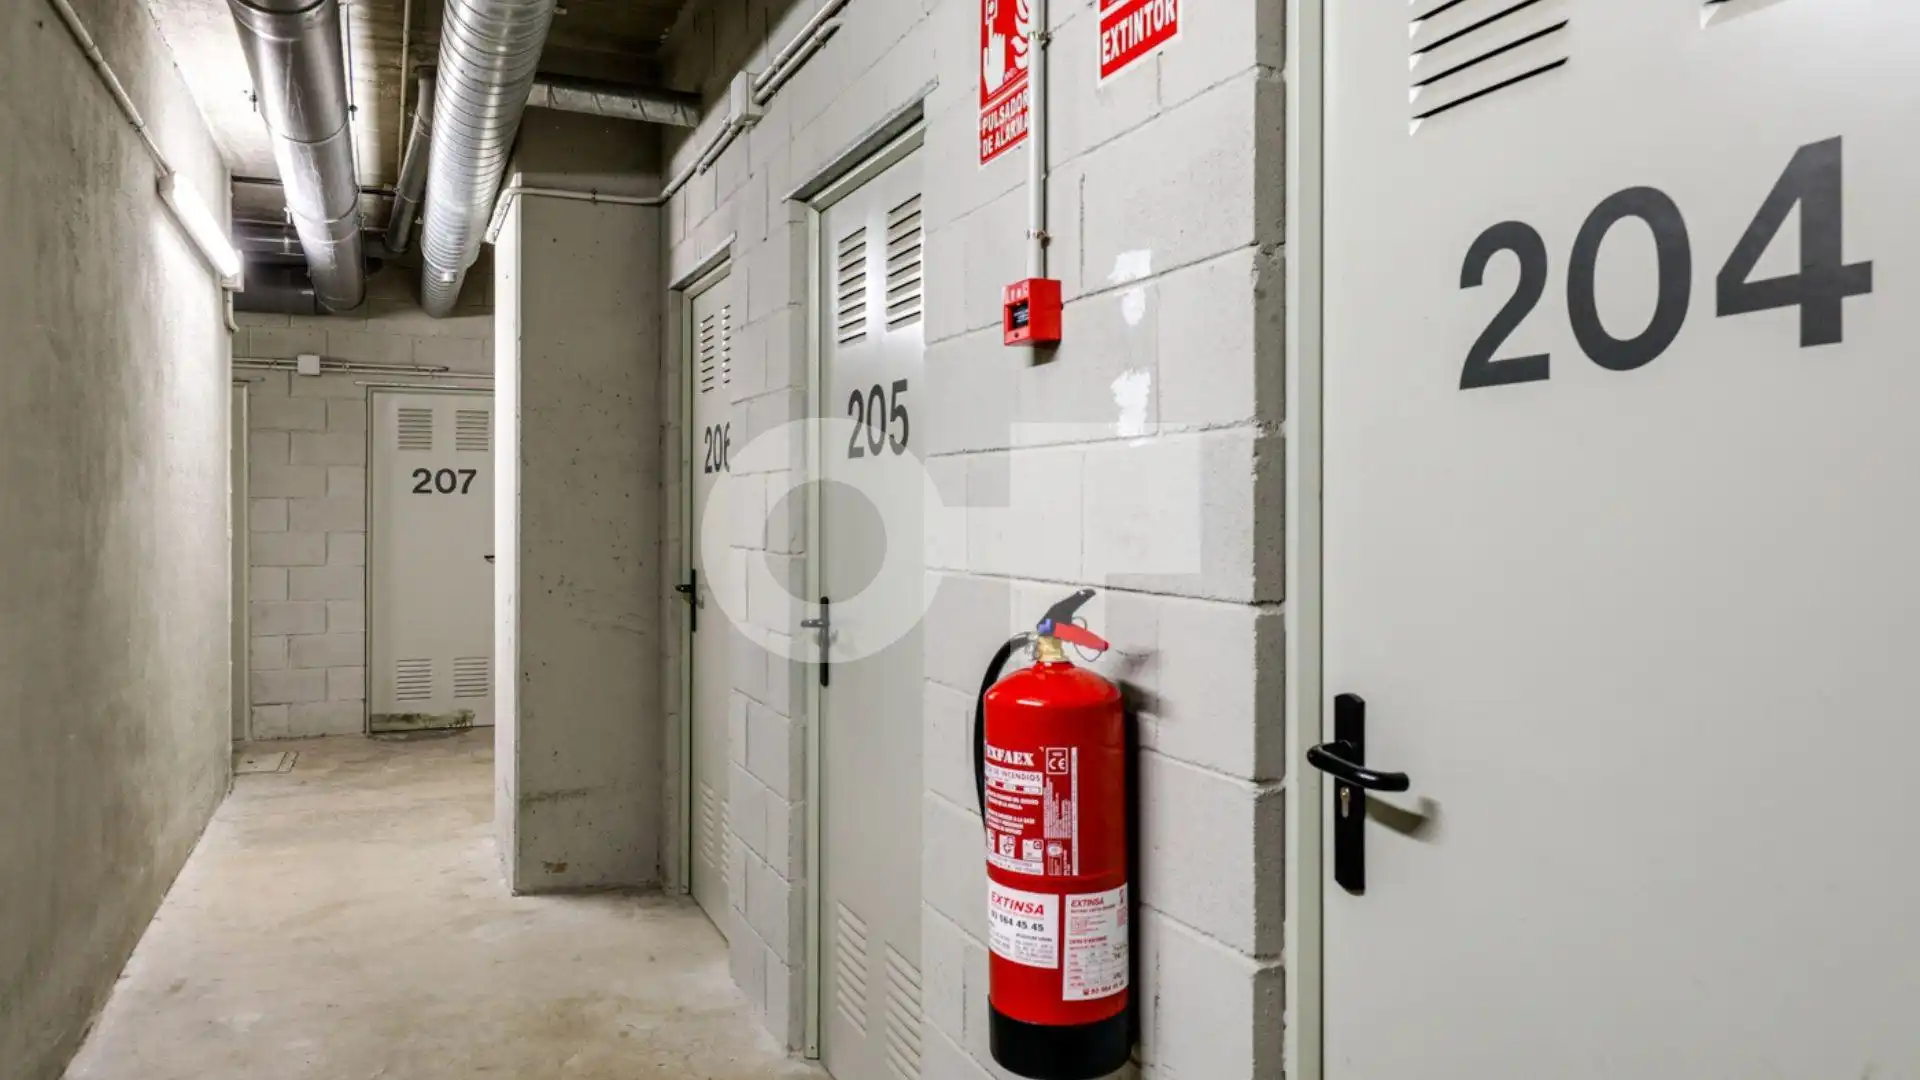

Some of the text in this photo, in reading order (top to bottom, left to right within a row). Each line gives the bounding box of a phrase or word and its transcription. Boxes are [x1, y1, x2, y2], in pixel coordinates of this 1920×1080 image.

[1102, 0, 1176, 66] EXTINTOR
[982, 88, 1028, 137] PULSADOR
[982, 133, 994, 158] DE
[1459, 134, 1873, 391] 204
[848, 378, 909, 459] 205
[412, 468, 477, 494] 207
[1002, 770, 1040, 782] INCENDIOS
[1048, 757, 1066, 771] CE
[992, 890, 1044, 915] EXTINSA
[1071, 896, 1105, 907] EXTINSA
[1016, 919, 1028, 930] 45
[1031, 922, 1045, 932] 45
